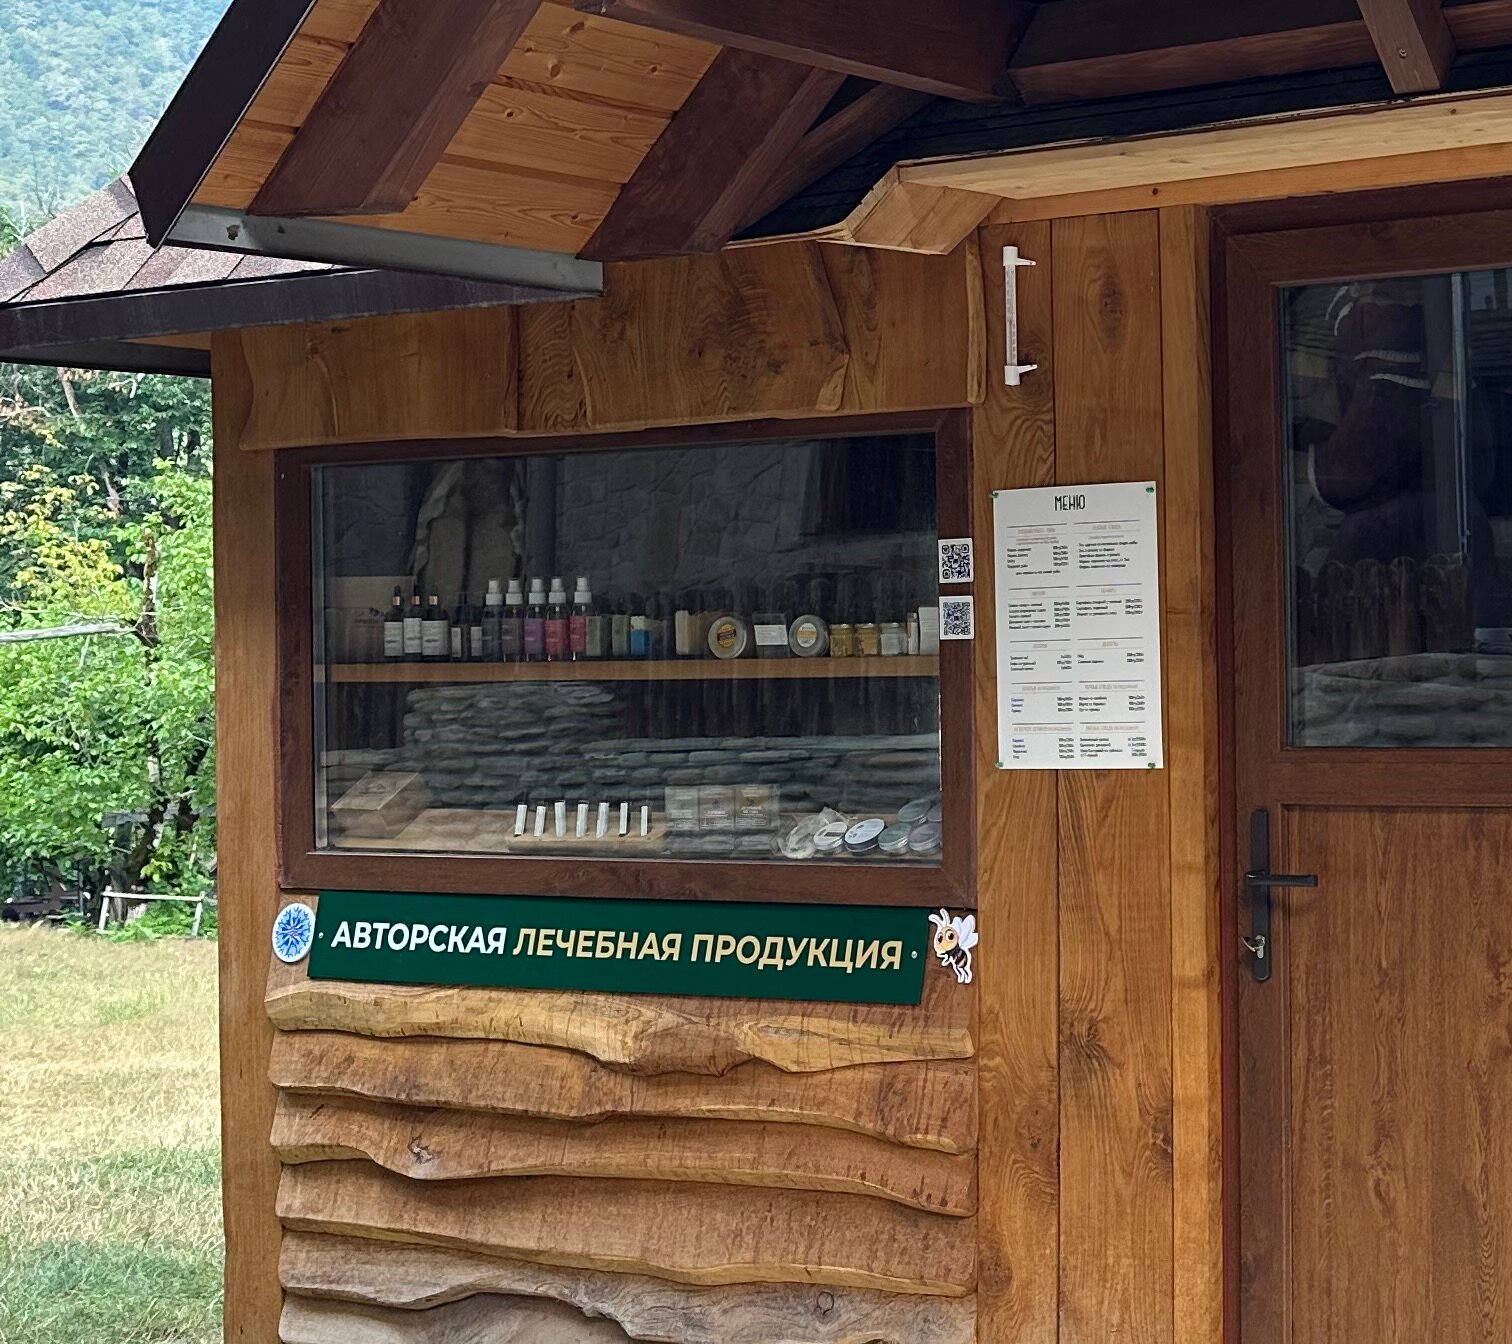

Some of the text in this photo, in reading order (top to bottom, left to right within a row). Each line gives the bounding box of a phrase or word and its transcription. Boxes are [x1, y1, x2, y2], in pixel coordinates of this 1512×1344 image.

[1054, 494, 1086, 512] МЕНЮ
[330, 920, 903, 974] АВТОРСКАЯ ЛЕЧЕБНАЯ ПРОДУКЦИЯ
